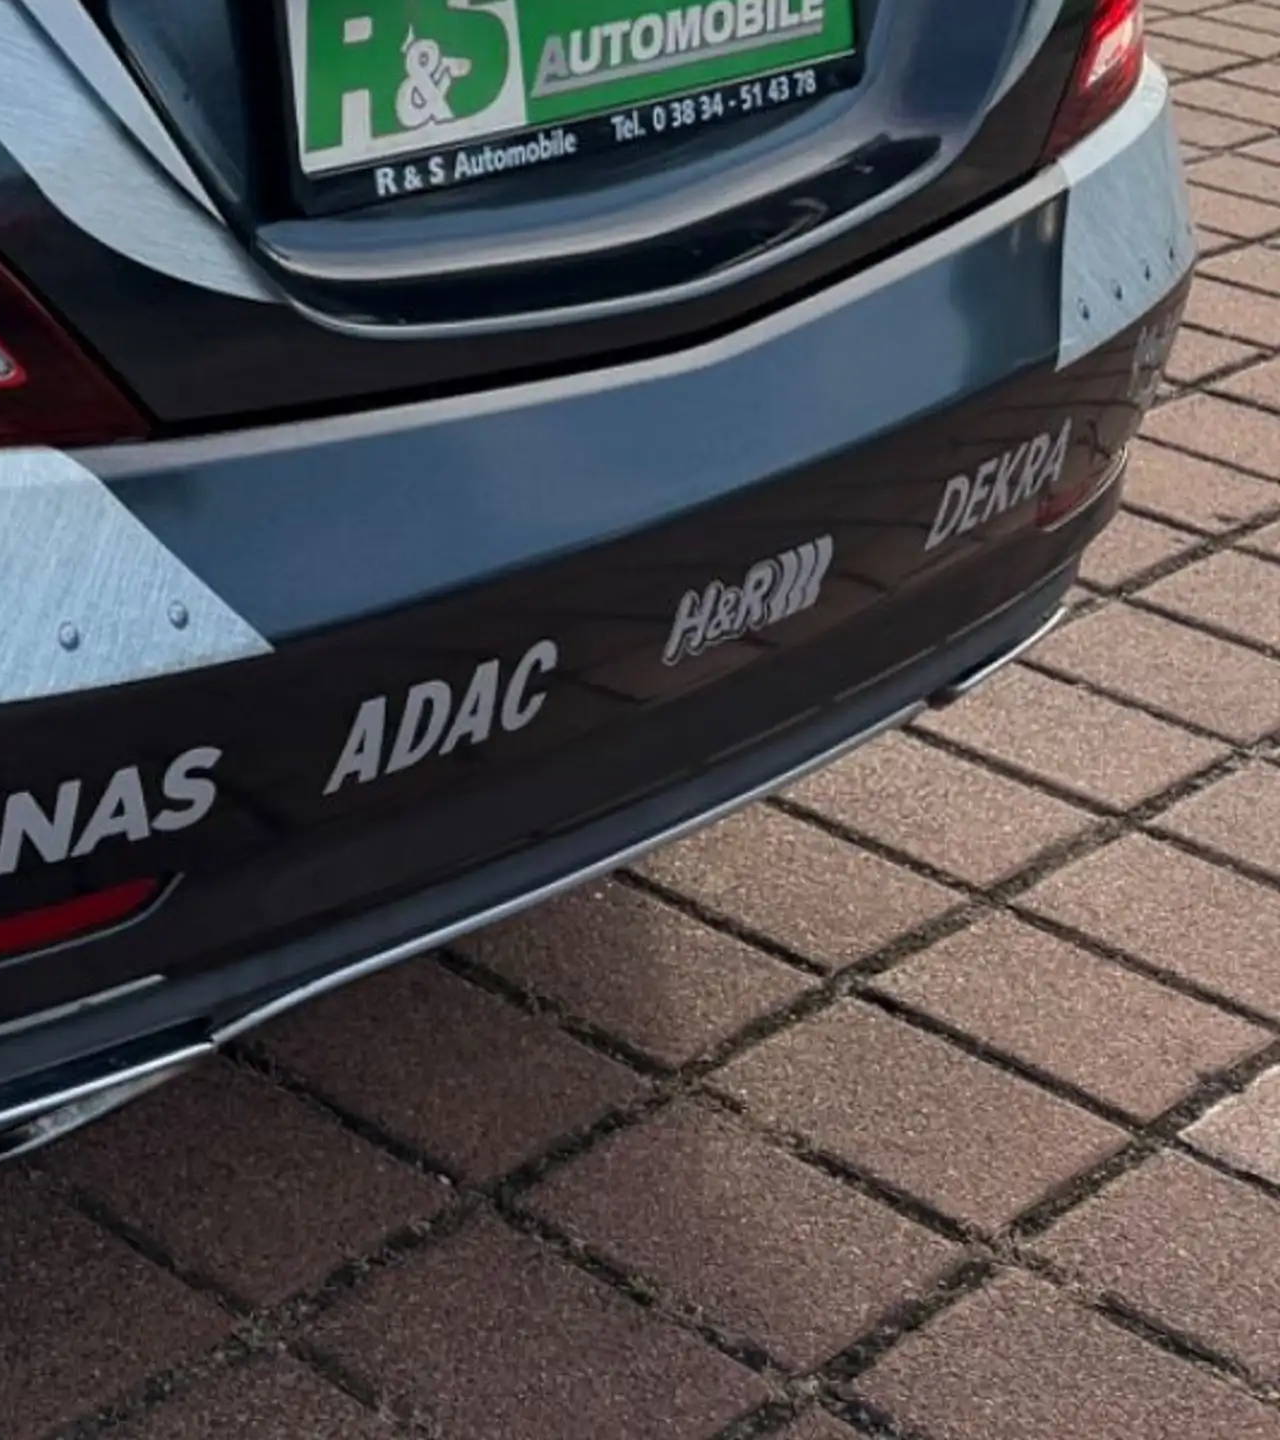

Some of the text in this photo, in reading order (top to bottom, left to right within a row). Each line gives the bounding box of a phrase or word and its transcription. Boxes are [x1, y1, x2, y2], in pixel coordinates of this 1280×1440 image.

[375, 167, 396, 197] R
[403, 166, 422, 189] &
[428, 158, 444, 185] S
[453, 129, 577, 180] Automobile
[610, 112, 645, 143] Tel.
[652, 107, 667, 133] 0
[670, 101, 696, 127] 38
[700, 95, 724, 122] 34
[740, 85, 764, 111] 51
[768, 78, 790, 104] 43
[794, 69, 817, 96] 78
[924, 416, 1072, 551] DEKRA
[661, 560, 781, 667] H&R
[322, 638, 560, 797] ADAC
